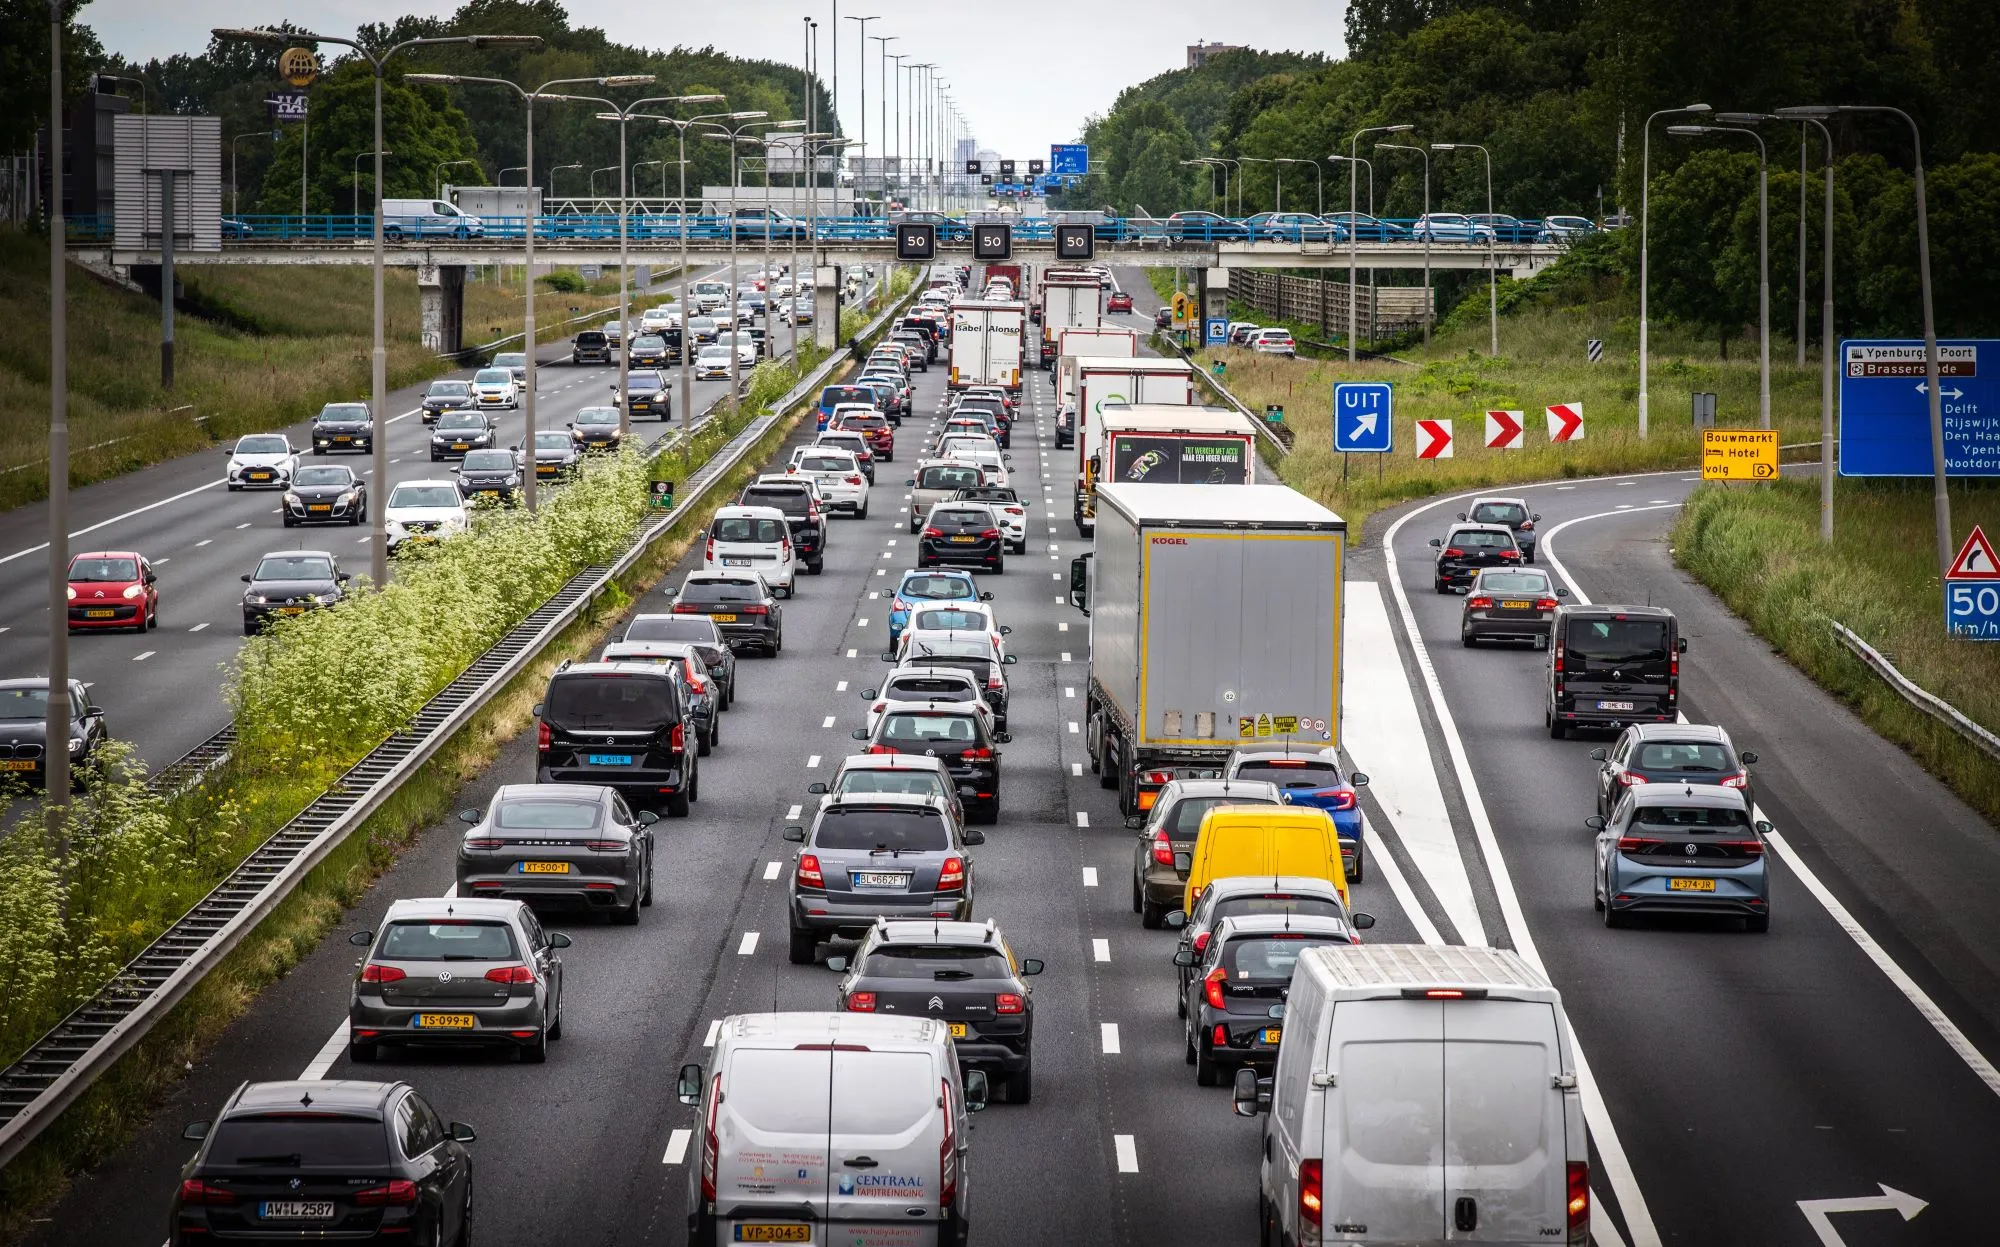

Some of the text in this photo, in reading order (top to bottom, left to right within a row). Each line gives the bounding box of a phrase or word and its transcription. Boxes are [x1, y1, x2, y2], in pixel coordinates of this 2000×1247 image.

[907, 236, 925, 246] 50
[984, 236, 1001, 247] 50
[1067, 237, 1084, 247] 50
[1940, 348, 1972, 357] Poort
[1345, 393, 1381, 408] UIT
[1945, 404, 1978, 414] Delft
[1945, 418, 1999, 430] Rijswijk
[1706, 433, 1773, 442] Bouwmarkt
[1945, 432, 1969, 441] Den
[1729, 448, 1759, 458] Hotel
[1944, 458, 2000, 468] Nootdor
[1706, 464, 1765, 476] volg G
[1953, 588, 1999, 616] 50
[1954, 620, 1998, 636] km/h
[423, 1016, 469, 1025] TS-099-R
[856, 1175, 923, 1186] CENTRAAL
[857, 1188, 924, 1197] TAPIJTREINIGING
[266, 1203, 283, 1216] AW
[301, 1203, 332, 1216] 2587
[747, 1228, 804, 1239] VP-304-S
